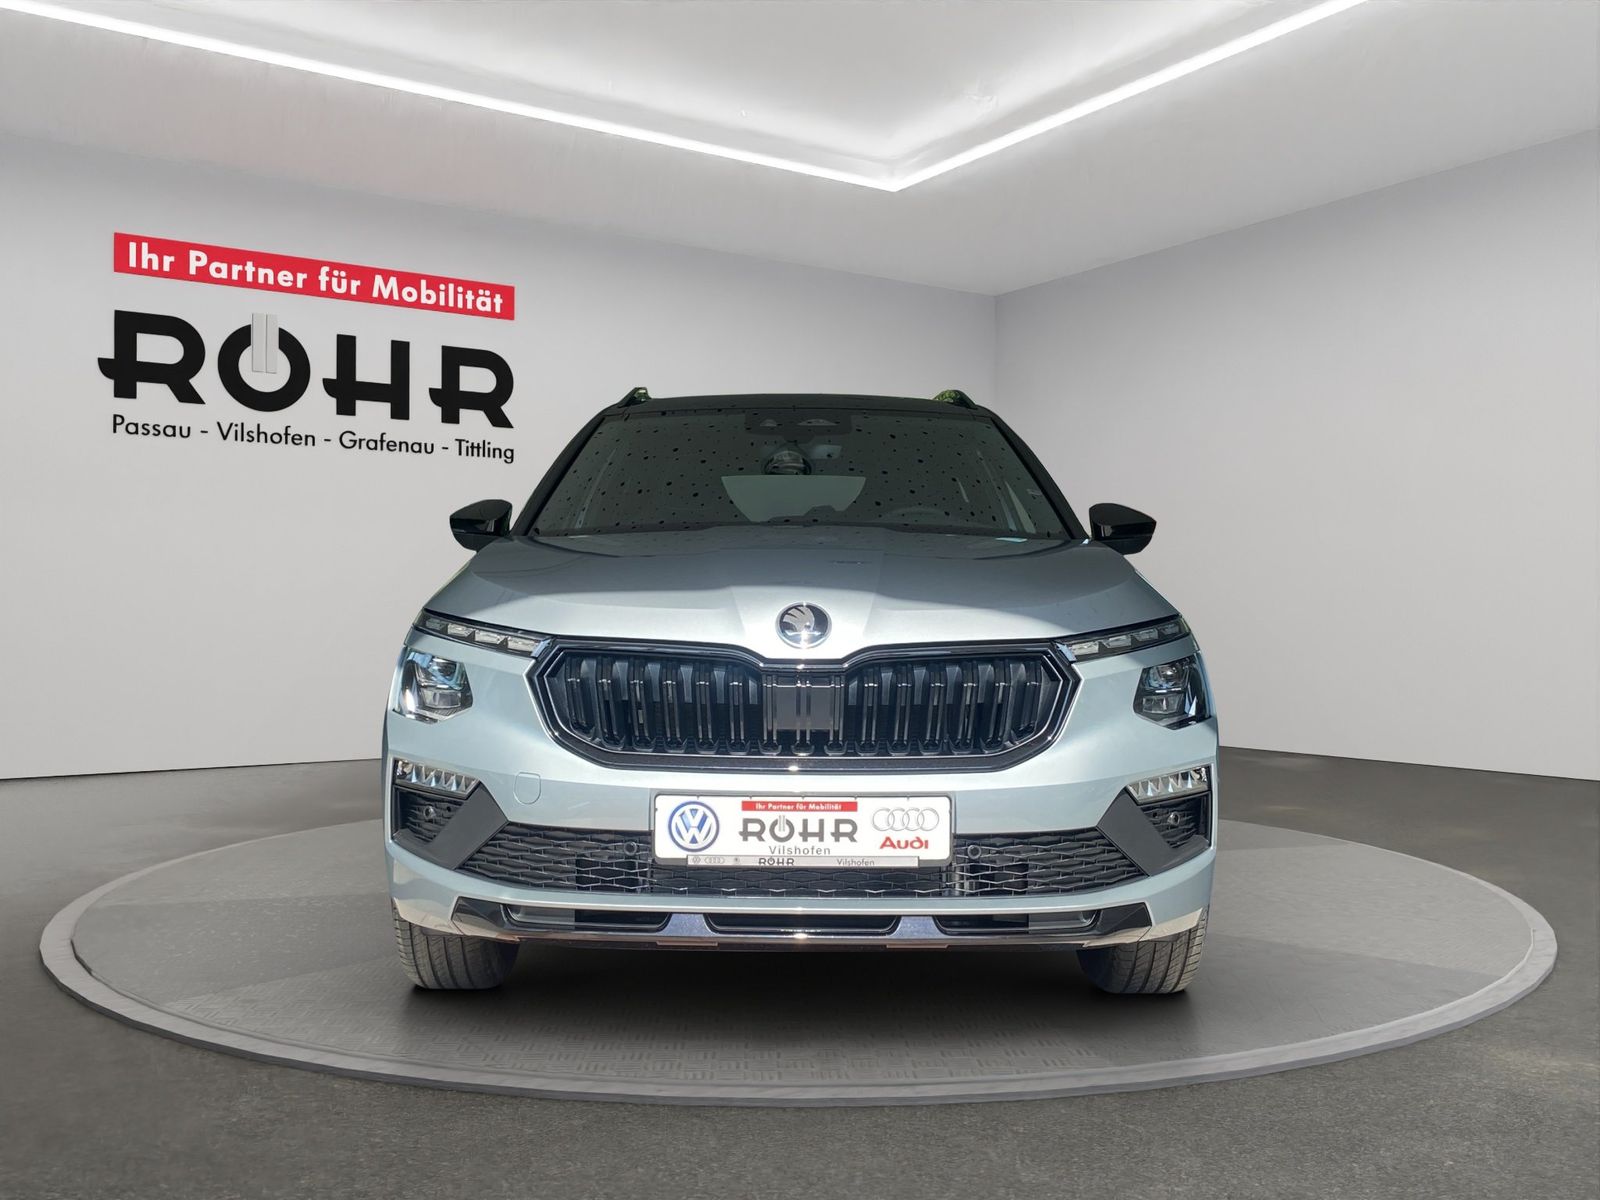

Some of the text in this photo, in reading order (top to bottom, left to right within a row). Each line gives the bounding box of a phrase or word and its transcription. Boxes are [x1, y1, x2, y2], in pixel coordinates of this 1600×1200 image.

[128, 241, 503, 314] Ihr Partner für Mobilität
[112, 413, 191, 439] Passau
[216, 421, 316, 447] Vilshofen
[338, 430, 435, 455] Grafenau
[454, 438, 515, 465] Tittling
[879, 836, 929, 849] Audi
[769, 845, 831, 856] Vilshofen
[836, 858, 875, 866] Vilshofen
